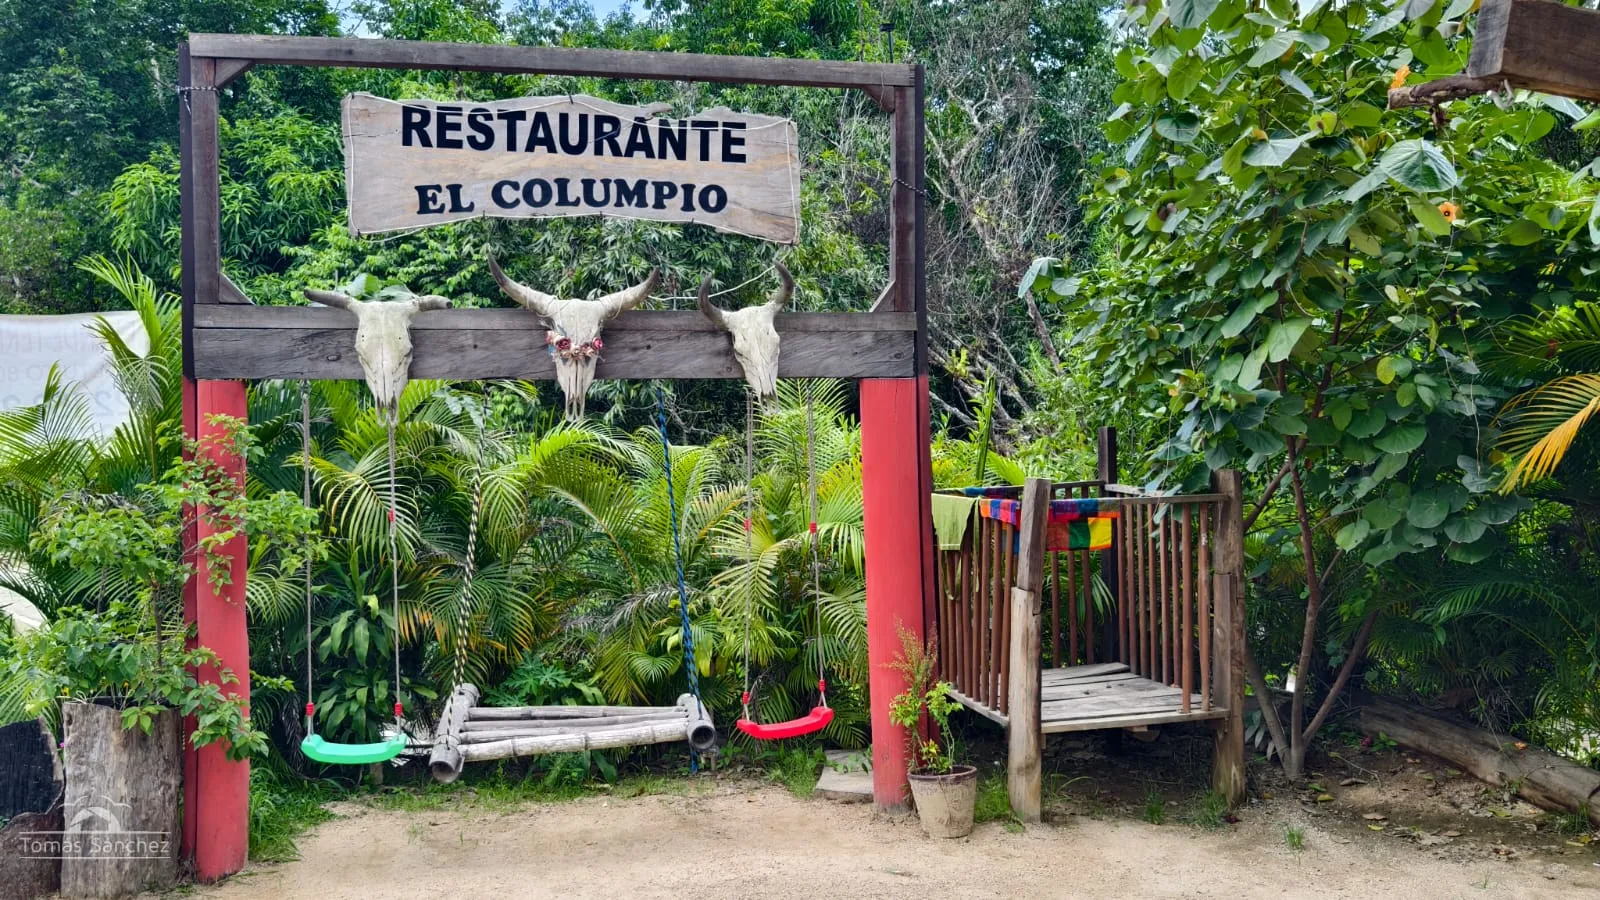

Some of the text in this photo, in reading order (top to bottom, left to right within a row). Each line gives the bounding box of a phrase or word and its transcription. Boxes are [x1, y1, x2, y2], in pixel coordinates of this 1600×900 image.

[401, 104, 748, 164] RESTAURANTE
[414, 177, 728, 215] EL COLUMPIO
